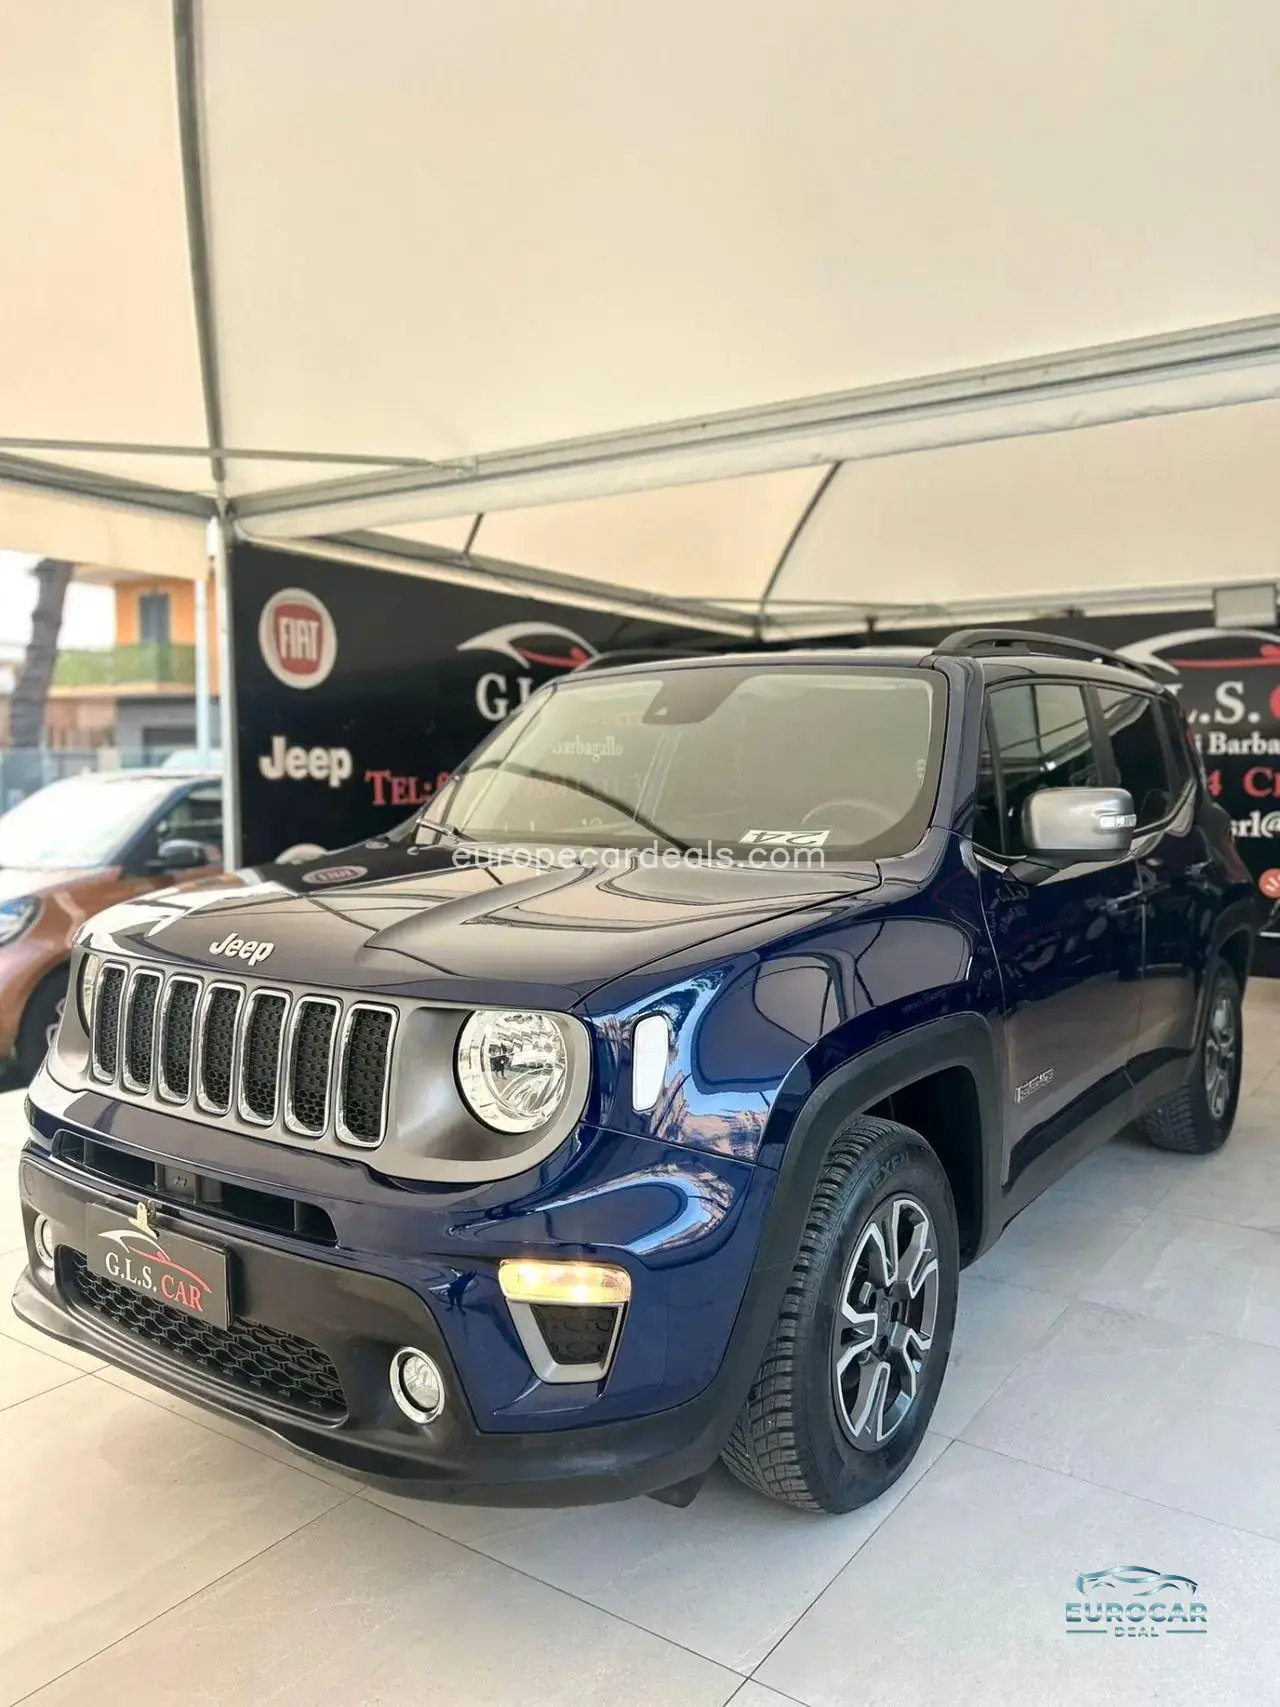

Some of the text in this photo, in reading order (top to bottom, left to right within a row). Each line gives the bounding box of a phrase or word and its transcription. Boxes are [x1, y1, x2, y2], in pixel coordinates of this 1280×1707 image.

[279, 616, 319, 662] FIAT
[259, 736, 352, 787] Jeep
[751, 831, 824, 846] 24
[209, 932, 275, 967] Jeep
[105, 1252, 203, 1312] G.L.S. CAR
